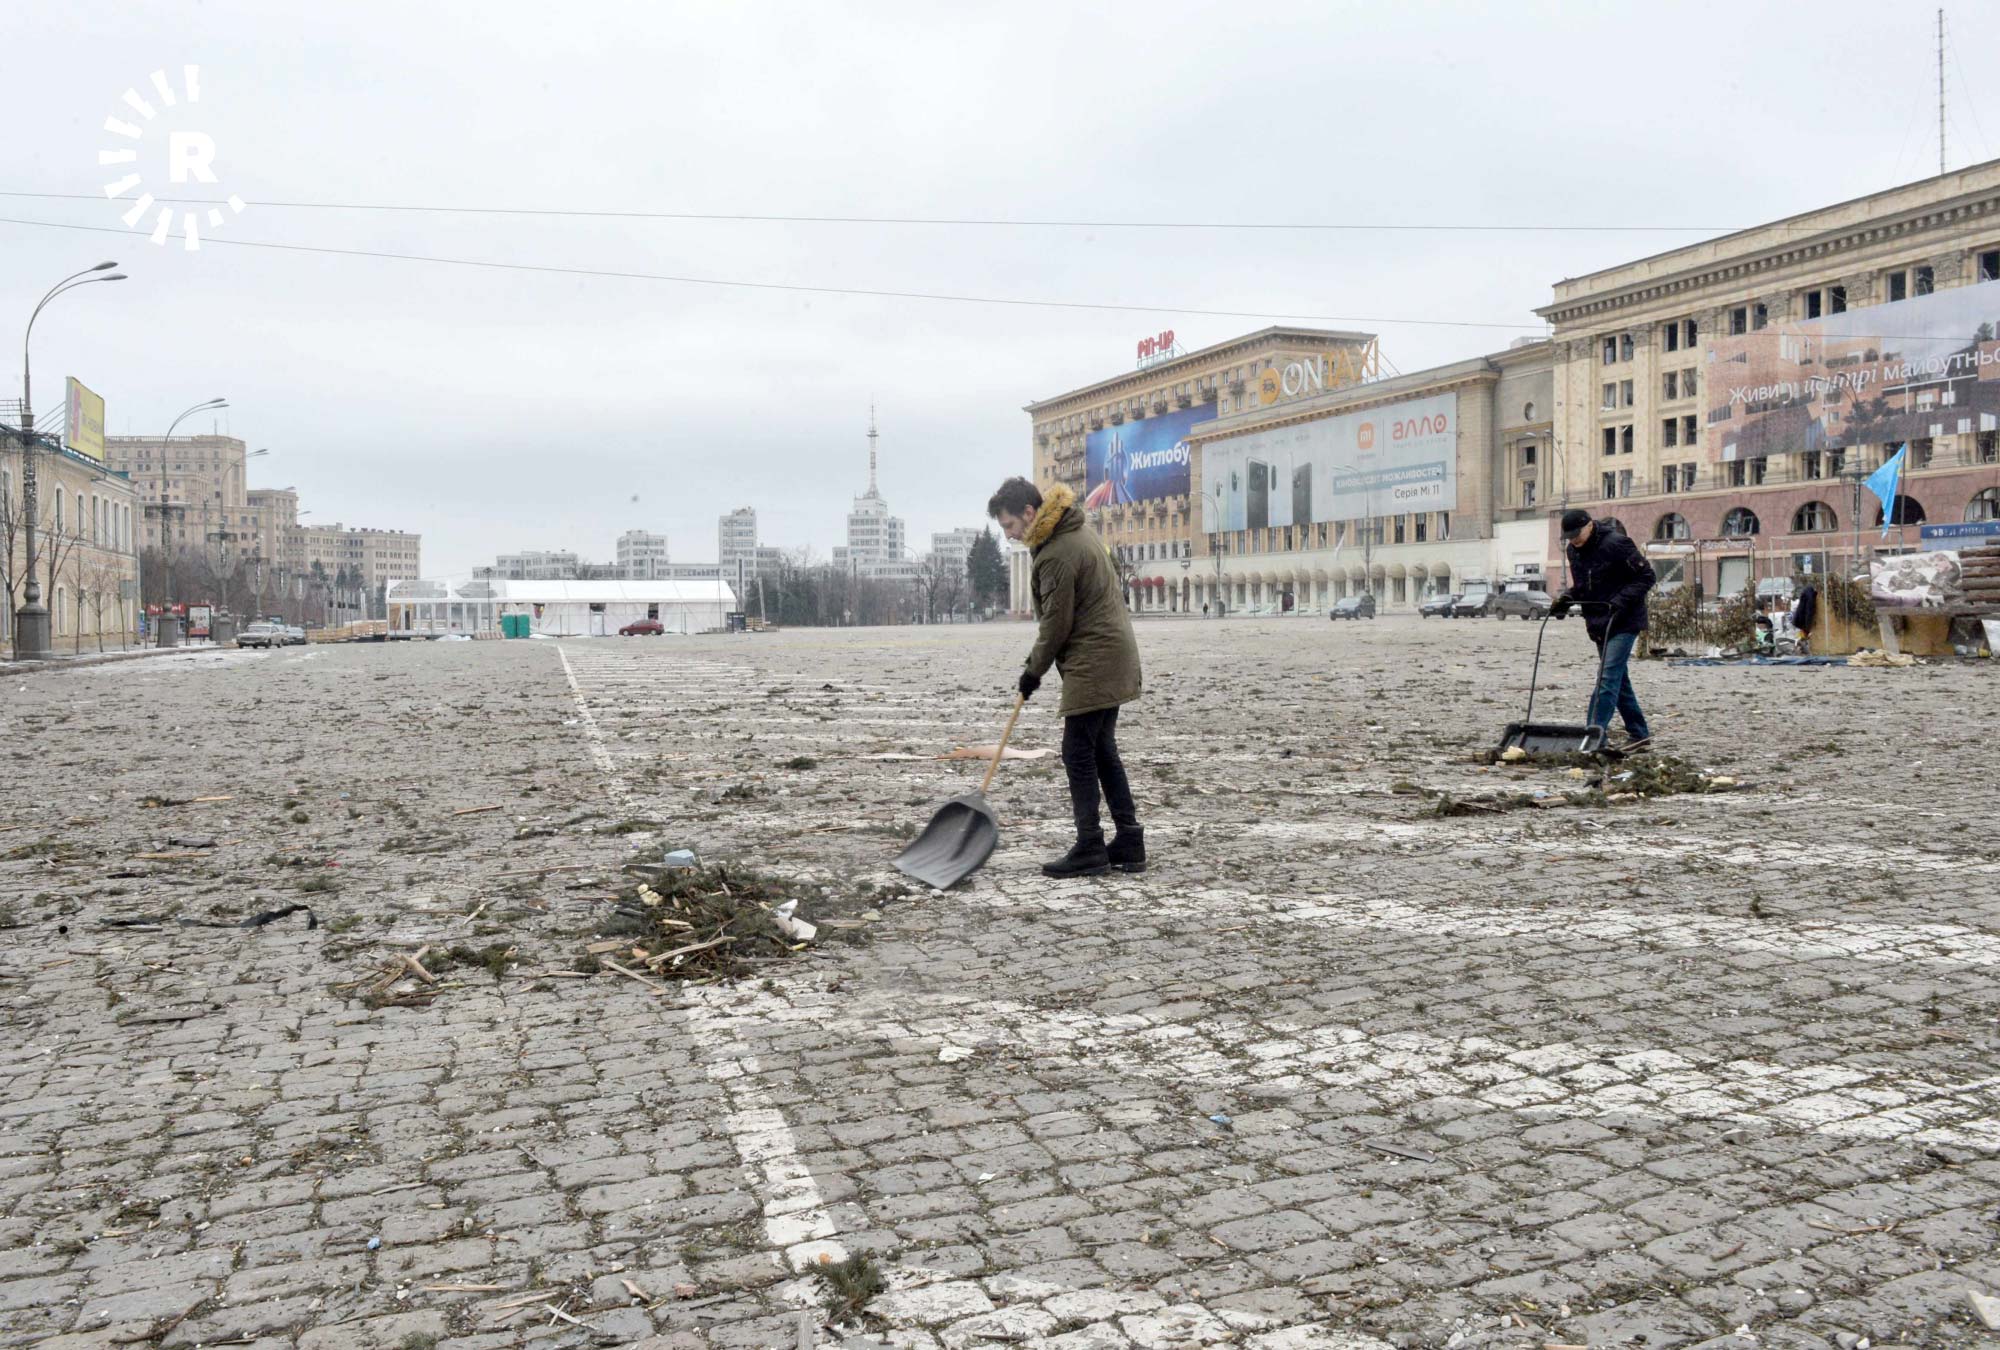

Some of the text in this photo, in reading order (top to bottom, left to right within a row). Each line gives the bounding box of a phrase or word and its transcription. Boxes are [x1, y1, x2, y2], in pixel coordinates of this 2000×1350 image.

[1729, 384, 1779, 406] Живи
[1130, 441, 1191, 470] Житлобу
[1394, 487, 1418, 500] Серія
